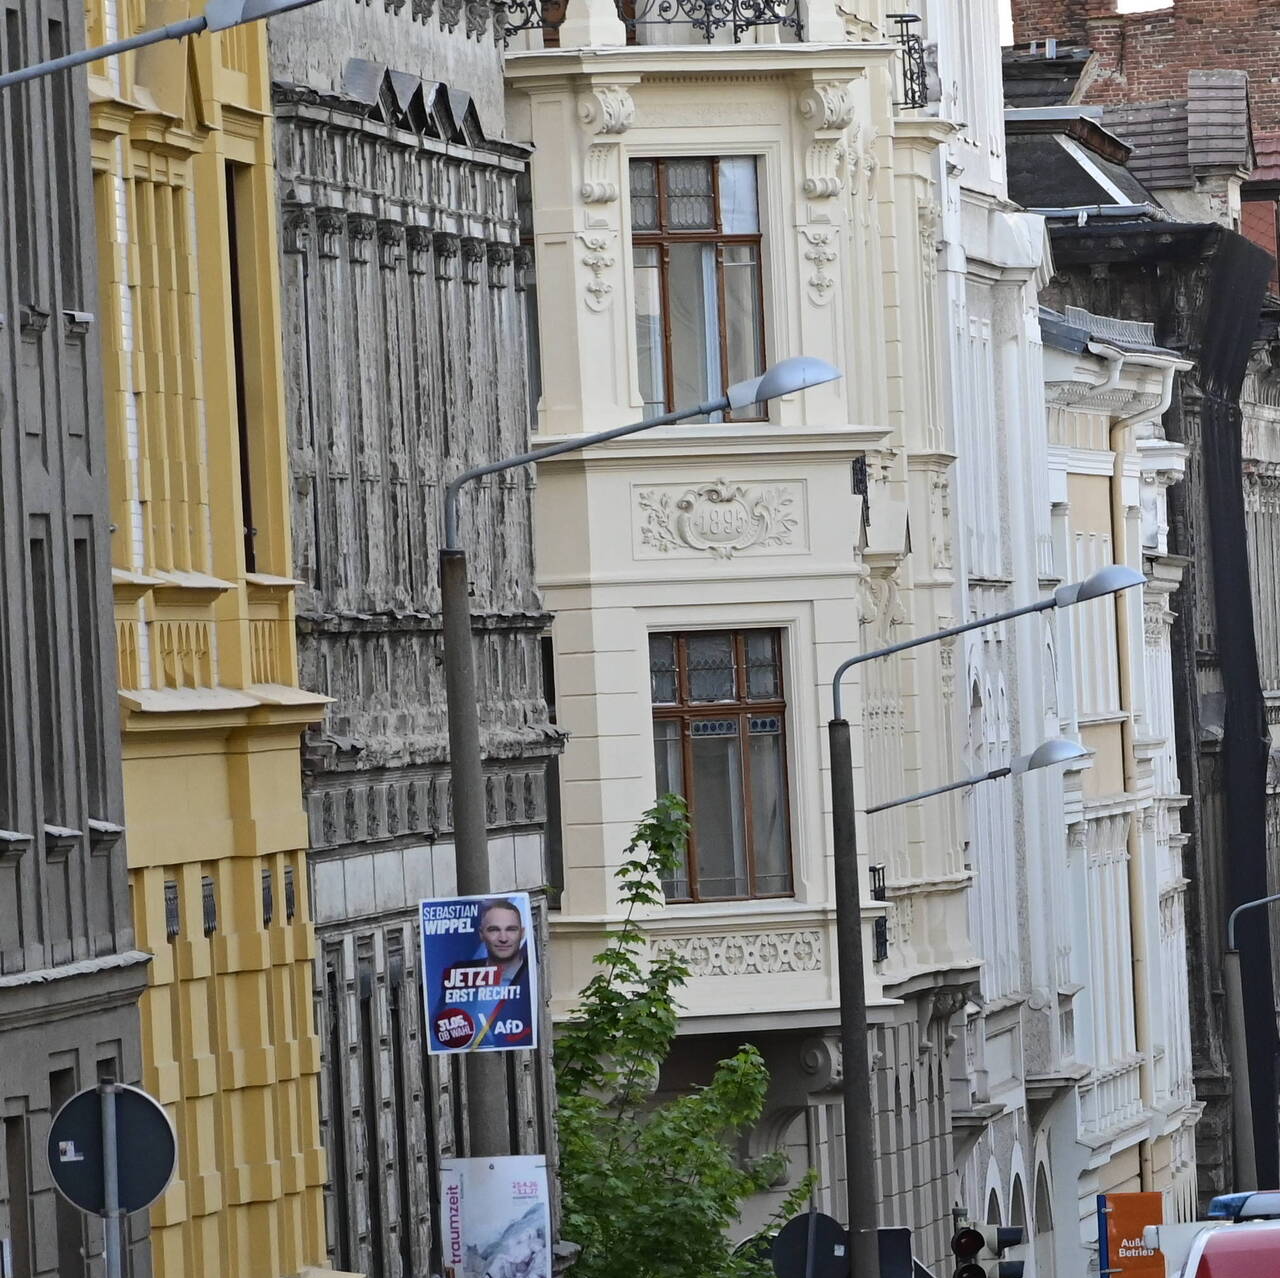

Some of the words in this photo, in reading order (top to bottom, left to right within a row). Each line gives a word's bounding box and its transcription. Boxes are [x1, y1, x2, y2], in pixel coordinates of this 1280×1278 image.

[700, 508, 744, 535] 1895
[423, 904, 479, 920] SEBASTIAN
[424, 918, 475, 935] WIPPEL
[444, 966, 498, 988] JETZT
[445, 988, 476, 1003] ERST
[477, 985, 521, 1001] RECHT!
[438, 1030, 450, 1042] OB
[450, 1024, 473, 1038] WAHL
[494, 1019, 524, 1035] AfD
[445, 1184, 462, 1265] traumzeit
